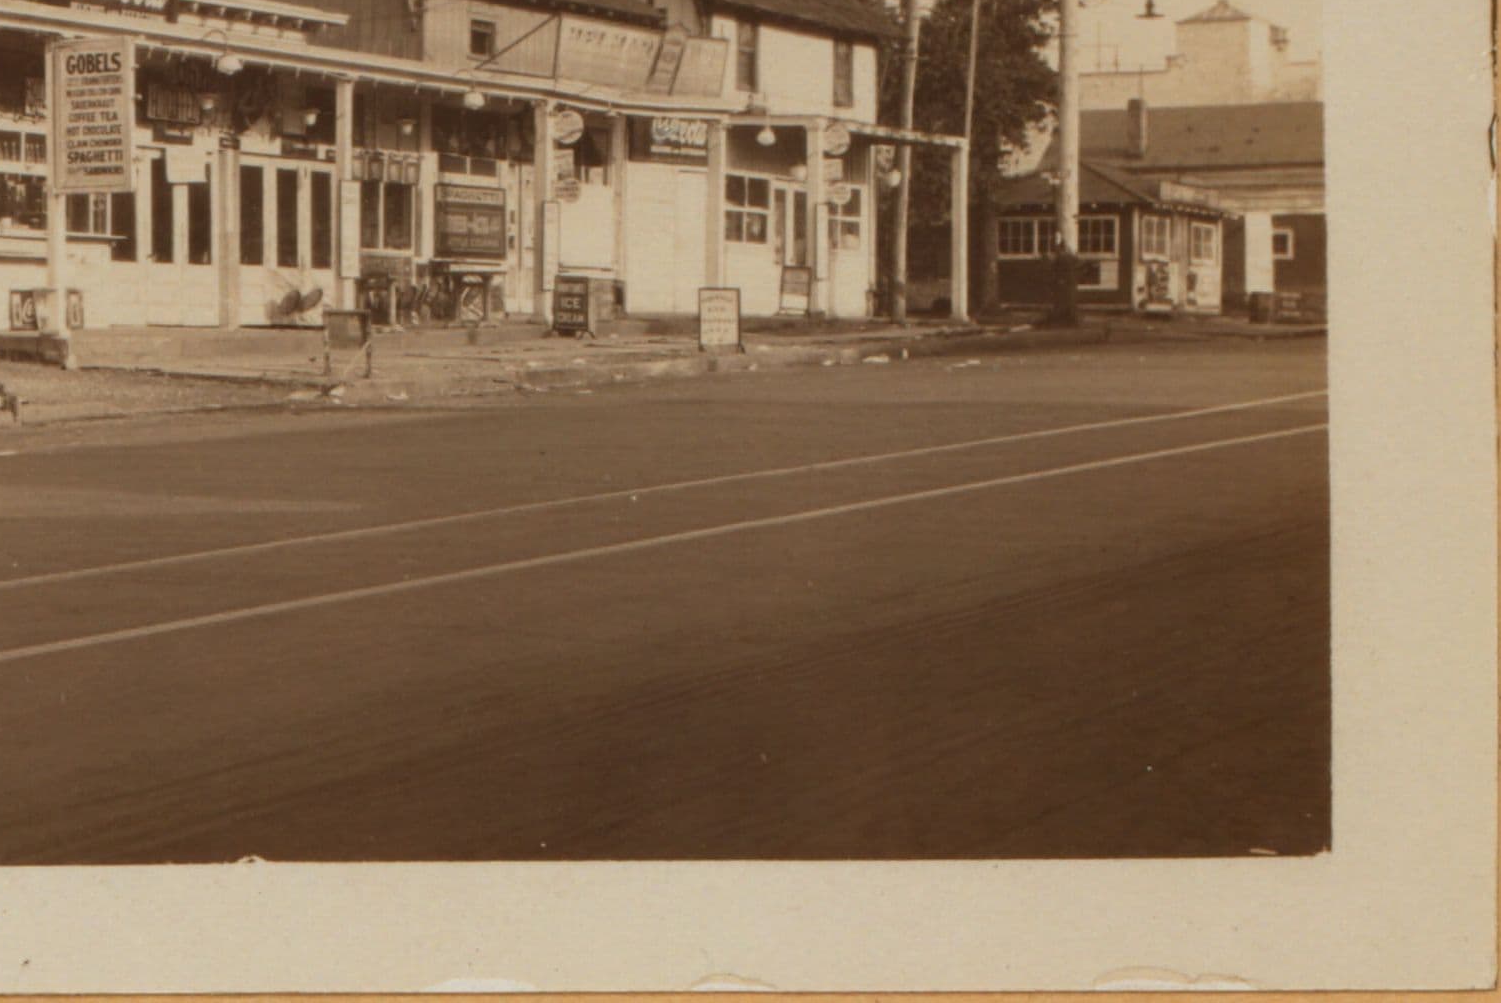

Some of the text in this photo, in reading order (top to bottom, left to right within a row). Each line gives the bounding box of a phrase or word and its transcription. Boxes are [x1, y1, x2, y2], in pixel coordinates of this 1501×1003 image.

[66, 51, 121, 75] GOBELS
[68, 110, 118, 123] COFFEE TEA
[66, 124, 122, 136] HOT CHOCOLATE
[66, 138, 122, 149] CLAM CHOWDER
[66, 149, 123, 165] SPAGHETTI
[560, 296, 581, 309] ICE
